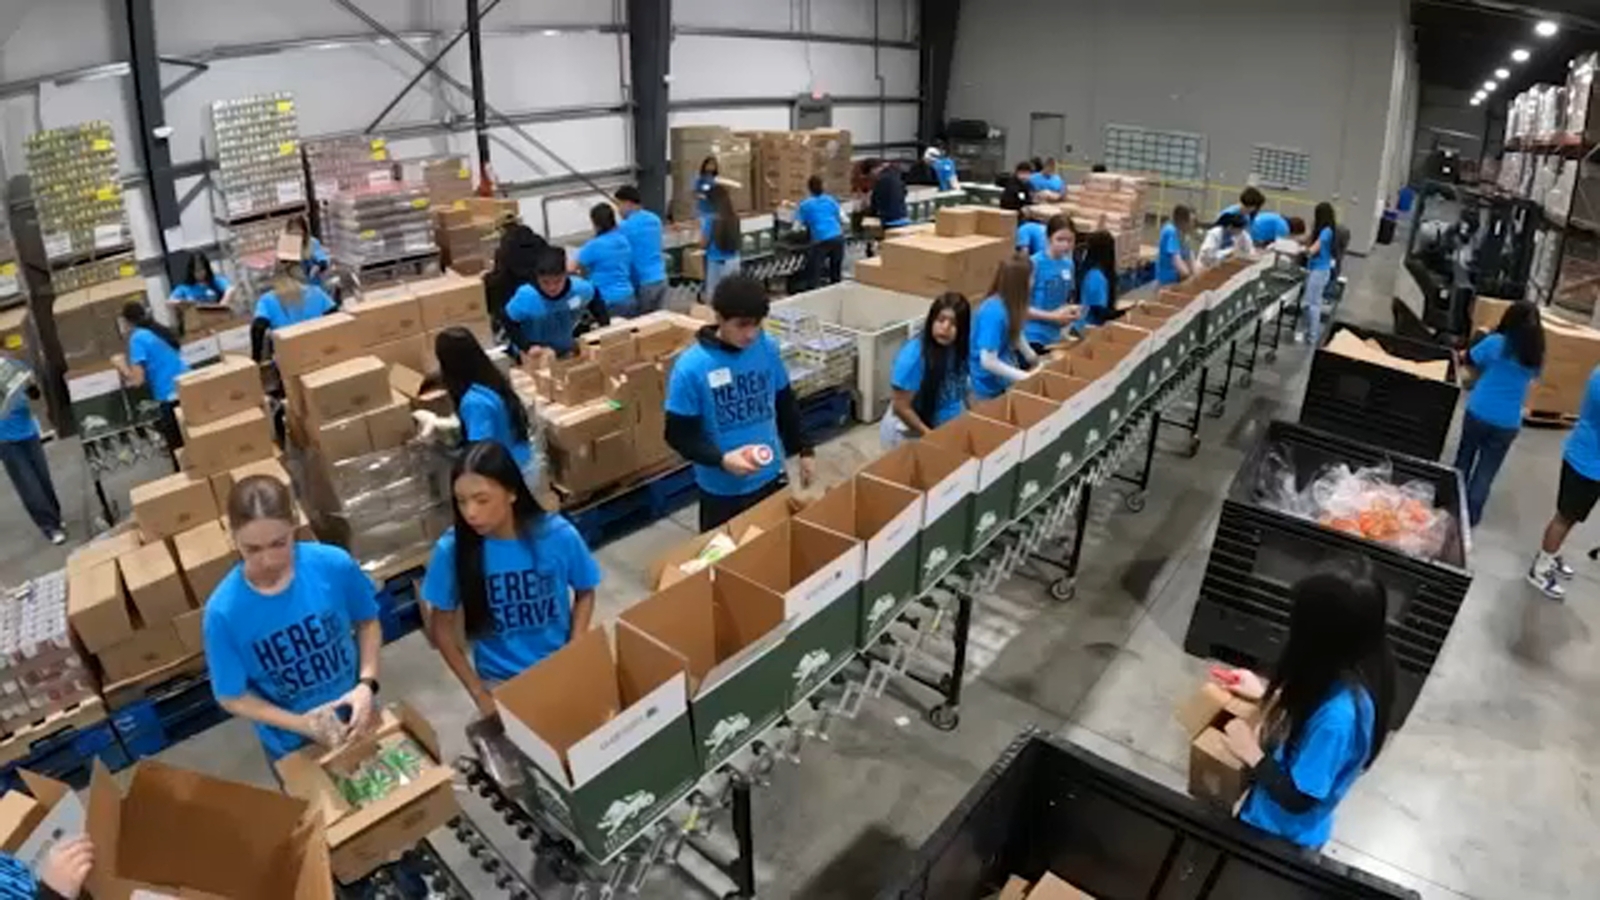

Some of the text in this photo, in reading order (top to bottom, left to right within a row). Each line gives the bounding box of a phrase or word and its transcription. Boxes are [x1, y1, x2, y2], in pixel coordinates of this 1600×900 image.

[489, 569, 538, 605] ERE
[252, 614, 327, 671] HERE
[281, 637, 350, 694] SERVE
